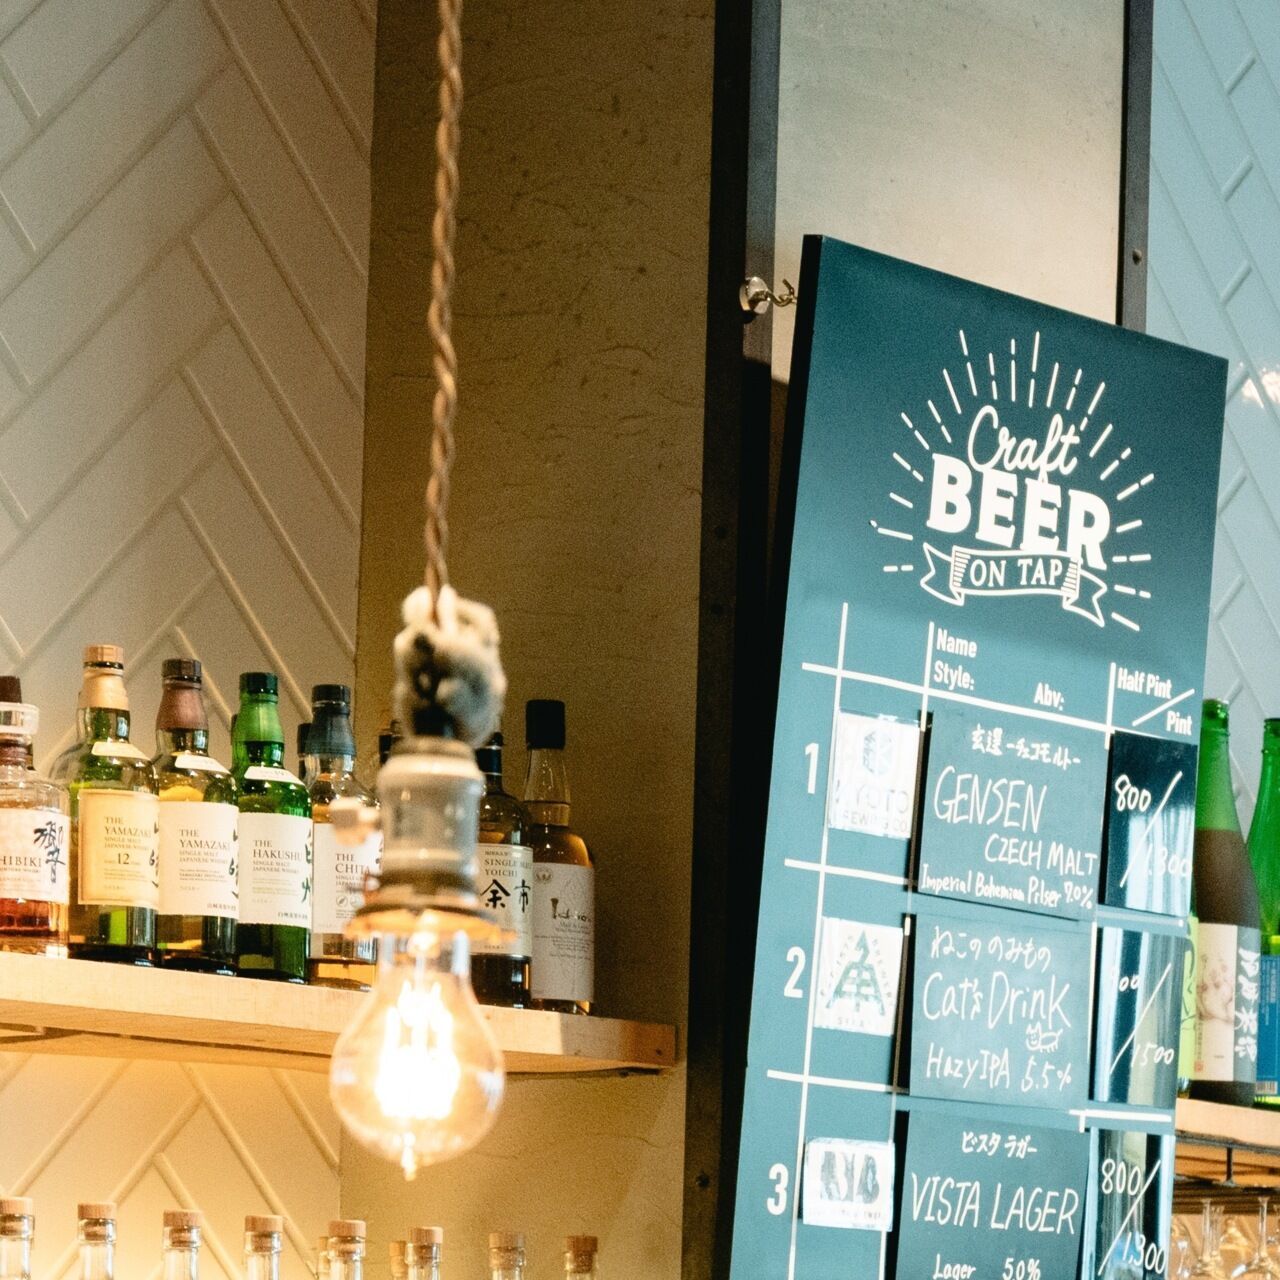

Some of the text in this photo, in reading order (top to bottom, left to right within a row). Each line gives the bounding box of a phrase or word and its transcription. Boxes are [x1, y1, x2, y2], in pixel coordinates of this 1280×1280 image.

[968, 405, 1080, 483] Craft
[926, 453, 1110, 570] BEER
[969, 558, 1063, 587] ON TAP
[936, 628, 977, 658] Name
[934, 660, 1065, 711] Style: Abv:
[1117, 667, 1172, 699] Half Pint
[1166, 711, 1193, 736] Pint
[805, 742, 819, 794] 1
[934, 765, 1047, 834] GENSEN
[1115, 774, 1151, 812] 800
[104, 816, 124, 826] THE
[179, 829, 199, 838] THE
[116, 853, 130, 865] 12
[179, 839, 231, 851] YAMAZAKI
[253, 839, 272, 848] THE
[253, 849, 302, 862] HAKUSHU
[336, 853, 354, 862] THE
[485, 858, 516, 867] SINGLE
[984, 833, 1098, 876] CZECH MALT
[335, 863, 370, 875] CHITA
[485, 869, 517, 877] YOICHI
[922, 863, 971, 896] Imperial
[975, 871, 1025, 902] Bohemian
[1064, 881, 1094, 911] 7.0%
[931, 925, 1051, 973] ねこの のみもの
[784, 946, 806, 998] 2
[923, 970, 1072, 1030] Cat's Drink
[926, 1042, 1072, 1092] Hazy IPA 5.5%
[961, 1131, 1038, 1159] ビスタ ラガー
[767, 1163, 789, 1216] 3
[1101, 1158, 1142, 1196] 800
[911, 1172, 981, 1228] VISTA
[990, 1182, 1079, 1235] LAGER
[1123, 1231, 1167, 1274] 1,300
